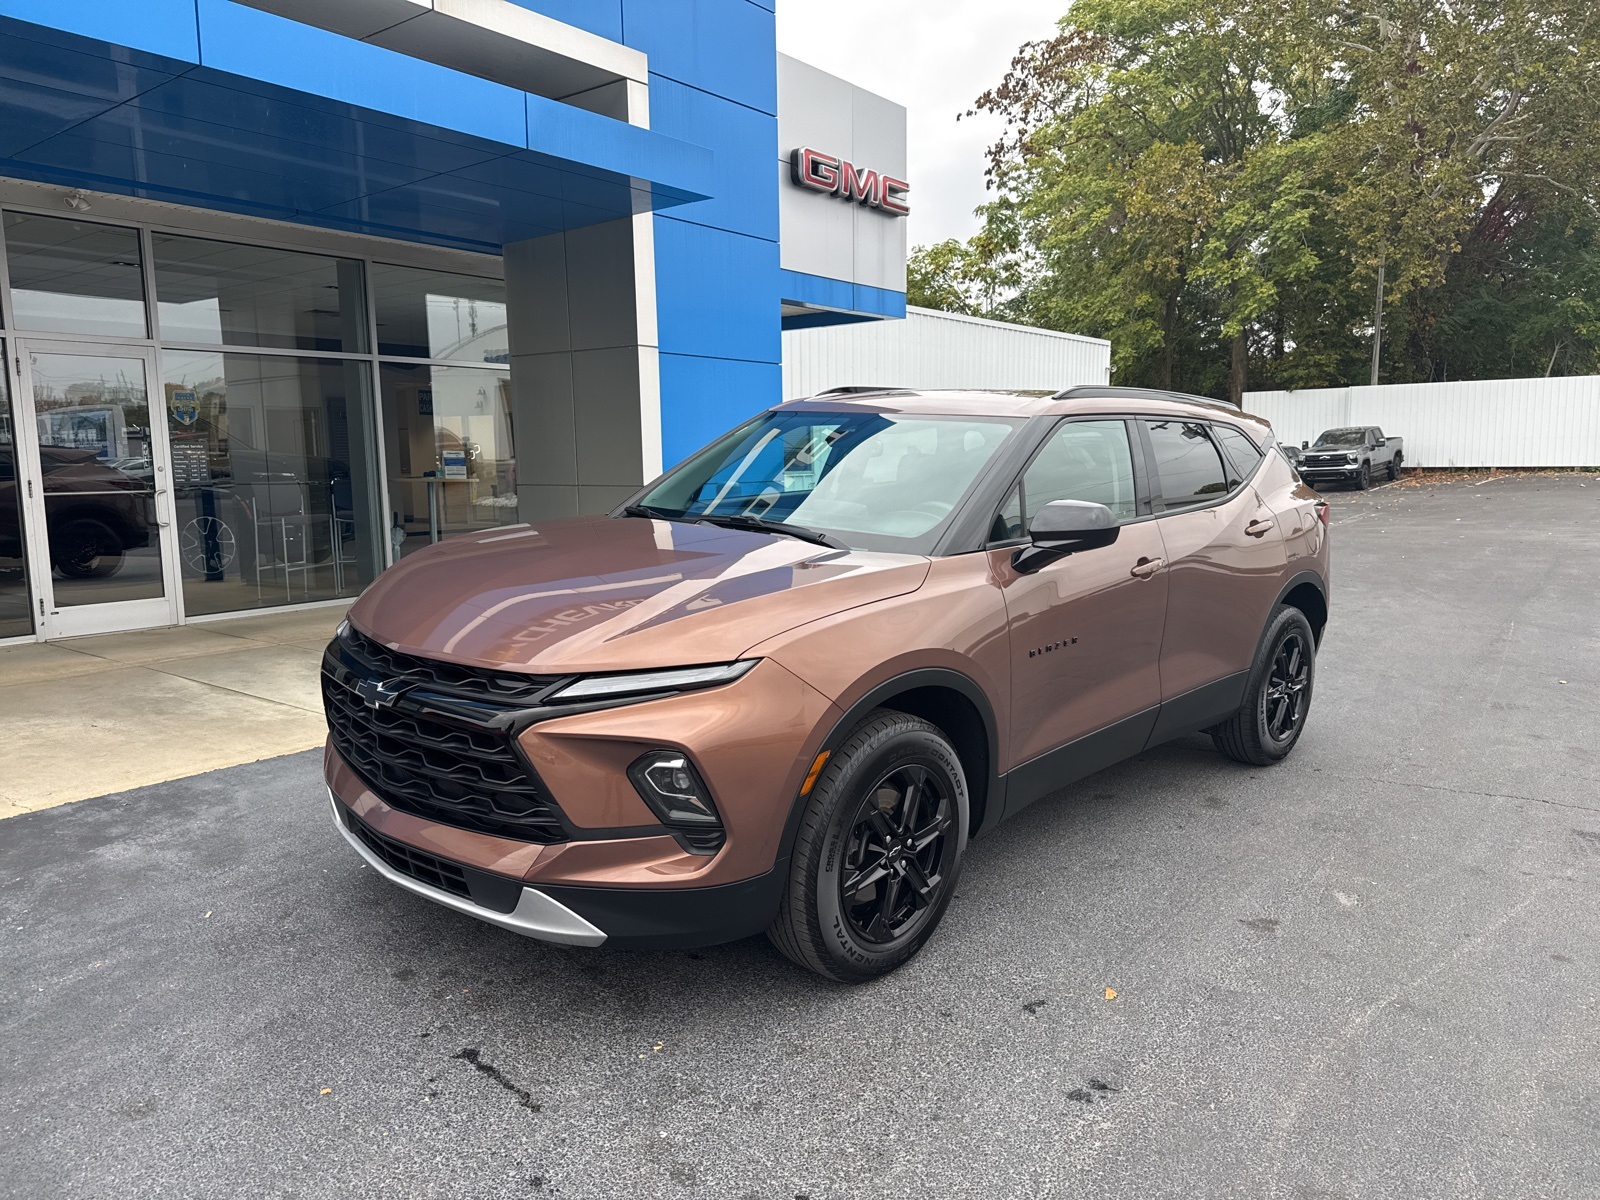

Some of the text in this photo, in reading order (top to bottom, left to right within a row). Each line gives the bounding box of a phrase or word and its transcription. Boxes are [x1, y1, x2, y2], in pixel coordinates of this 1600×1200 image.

[790, 146, 911, 217] GMC
[1029, 636, 1078, 658] BLAZER
[930, 748, 964, 798] CONTACT
